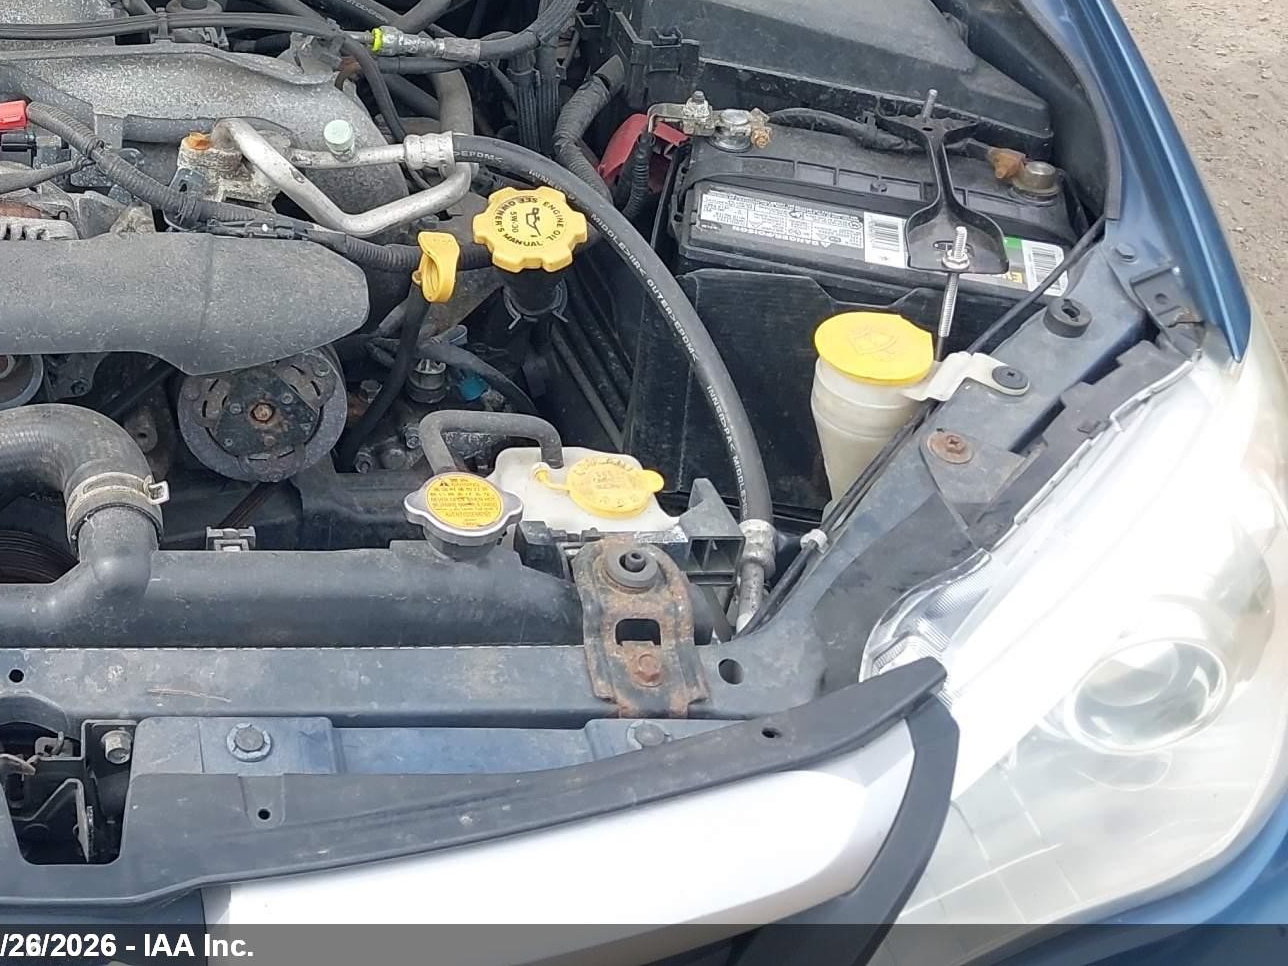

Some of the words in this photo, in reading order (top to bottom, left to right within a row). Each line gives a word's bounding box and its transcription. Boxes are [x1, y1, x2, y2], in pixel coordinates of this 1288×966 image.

[495, 200, 516, 233] OWNER'S
[542, 201, 565, 228] ENGINE
[504, 233, 543, 247] MANUAL
[546, 229, 561, 241] OIL
